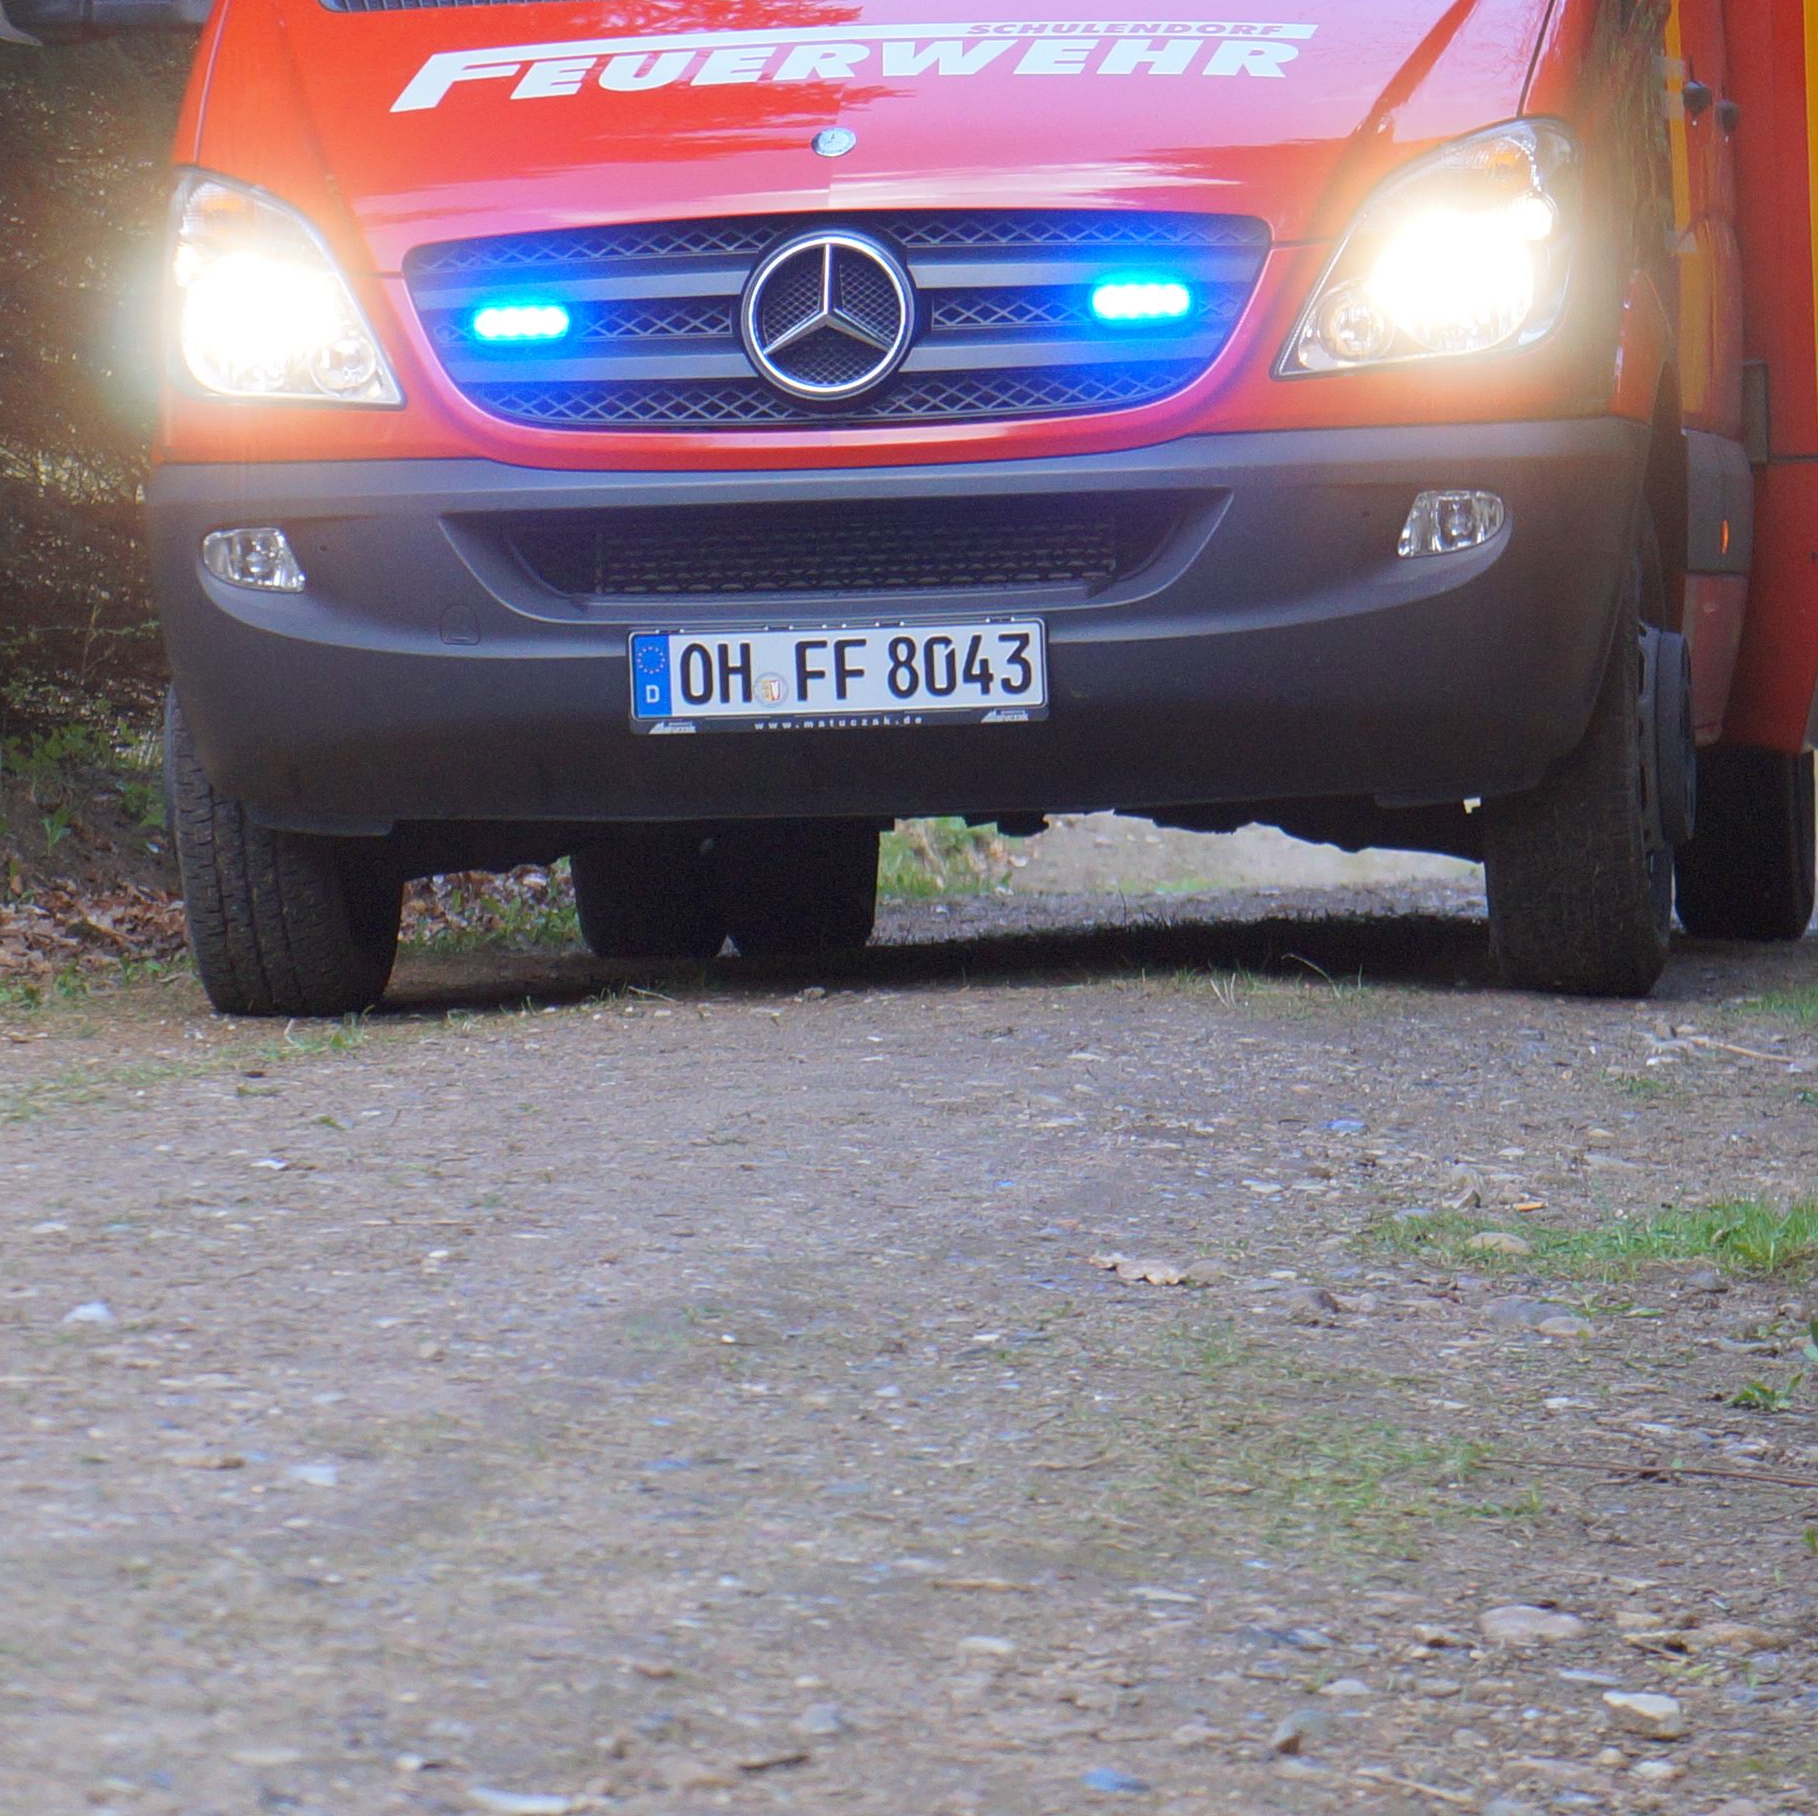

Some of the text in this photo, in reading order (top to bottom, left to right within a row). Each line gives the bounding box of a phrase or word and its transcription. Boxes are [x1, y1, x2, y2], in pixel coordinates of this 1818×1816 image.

[967, 22, 1284, 36] SCHULENDORF
[389, 21, 1318, 113] FEUERWEHR
[680, 632, 1033, 706] OH FF 8043
[646, 685, 660, 703] D
[754, 716, 923, 730] www.matuczak.de
